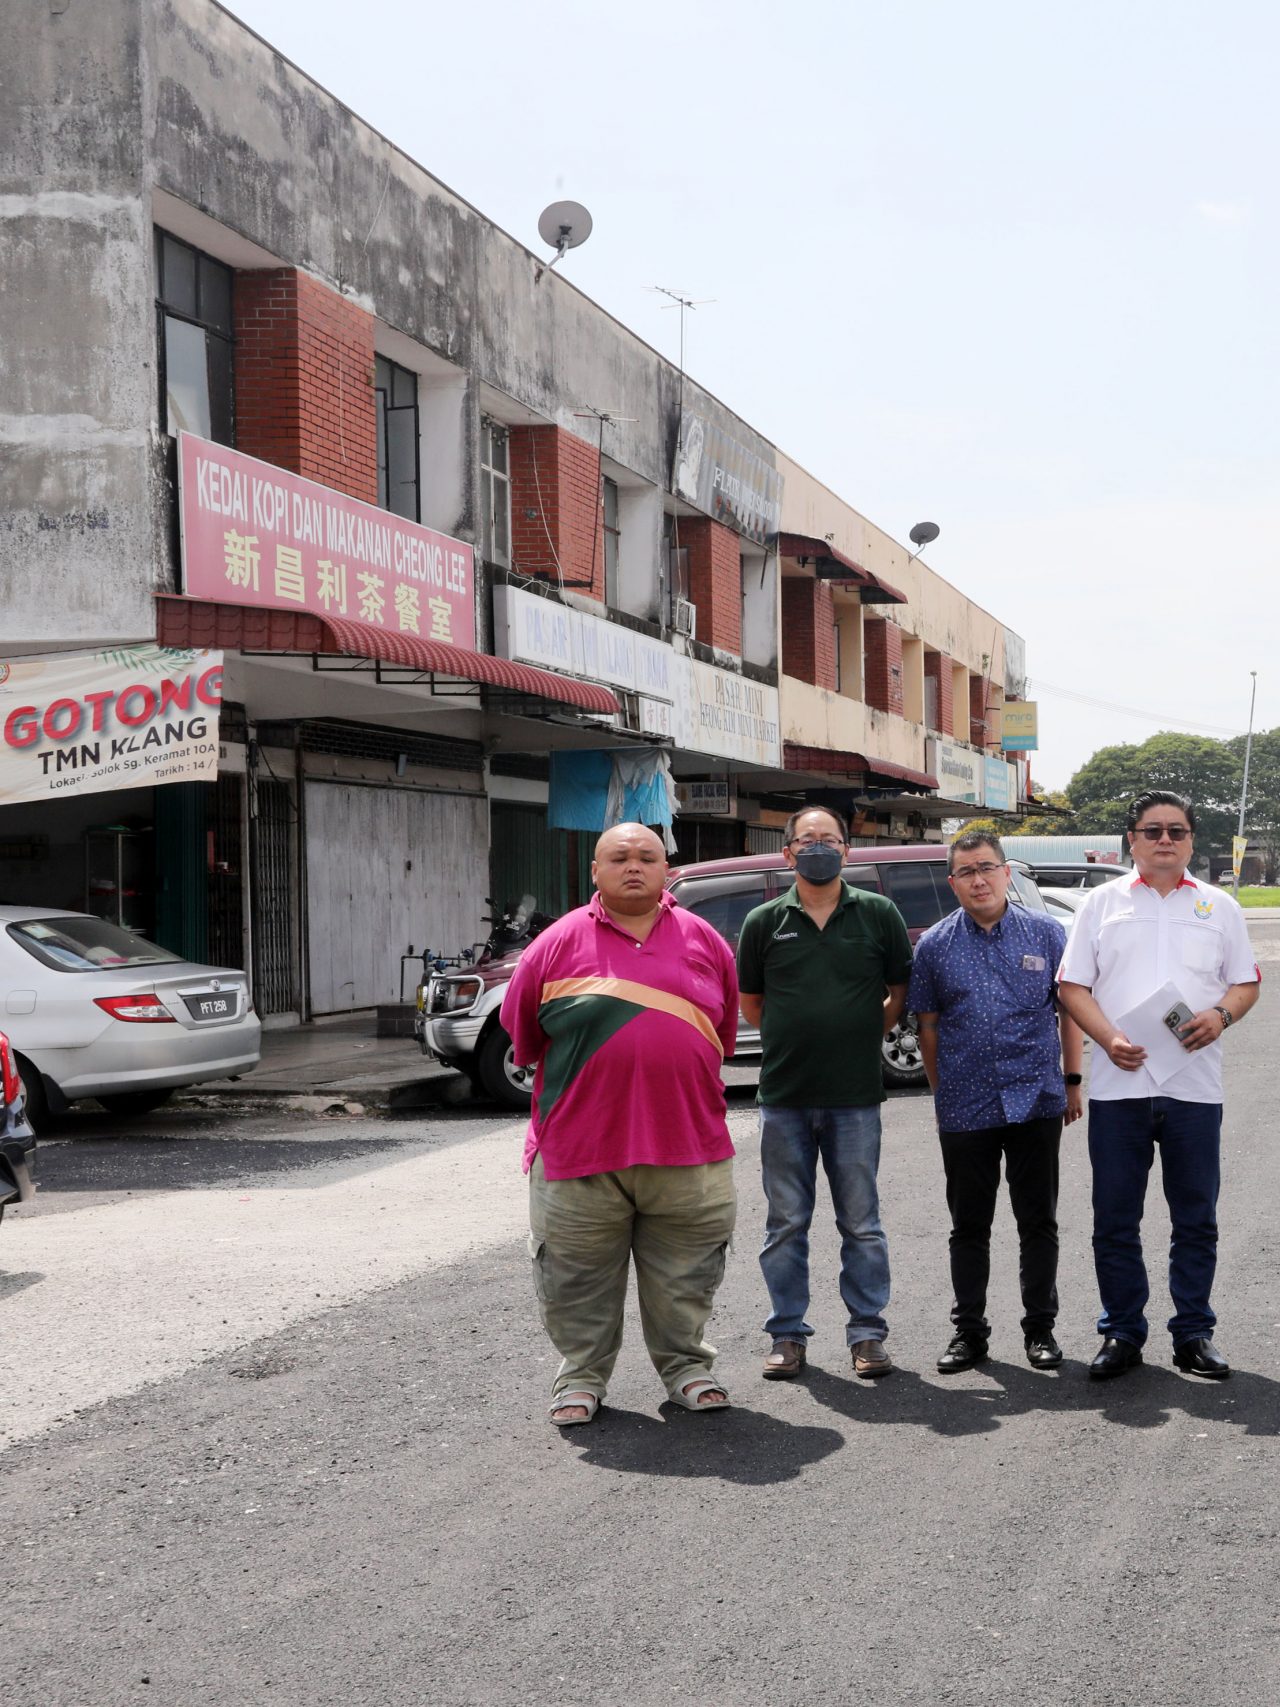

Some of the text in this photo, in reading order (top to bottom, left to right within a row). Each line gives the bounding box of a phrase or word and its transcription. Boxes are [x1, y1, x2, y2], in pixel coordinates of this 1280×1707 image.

[196, 457, 466, 594] KEDAI KOPI DAN MAKANAN CHEONG LEE
[223, 529, 453, 643] 新昌利茶餐室
[4, 665, 224, 748] GOTONG
[715, 675, 741, 710] PASAR
[744, 685, 764, 717] MINI
[38, 717, 207, 775] TMN KLANG
[737, 714, 752, 738] MINI
[753, 718, 777, 744] MARKET
[124, 759, 141, 769] Sg.
[144, 747, 190, 766] Keramat
[194, 744, 216, 755] 10A
[155, 765, 184, 778] Tarikh
[200, 1000, 227, 1014] PFT 258
